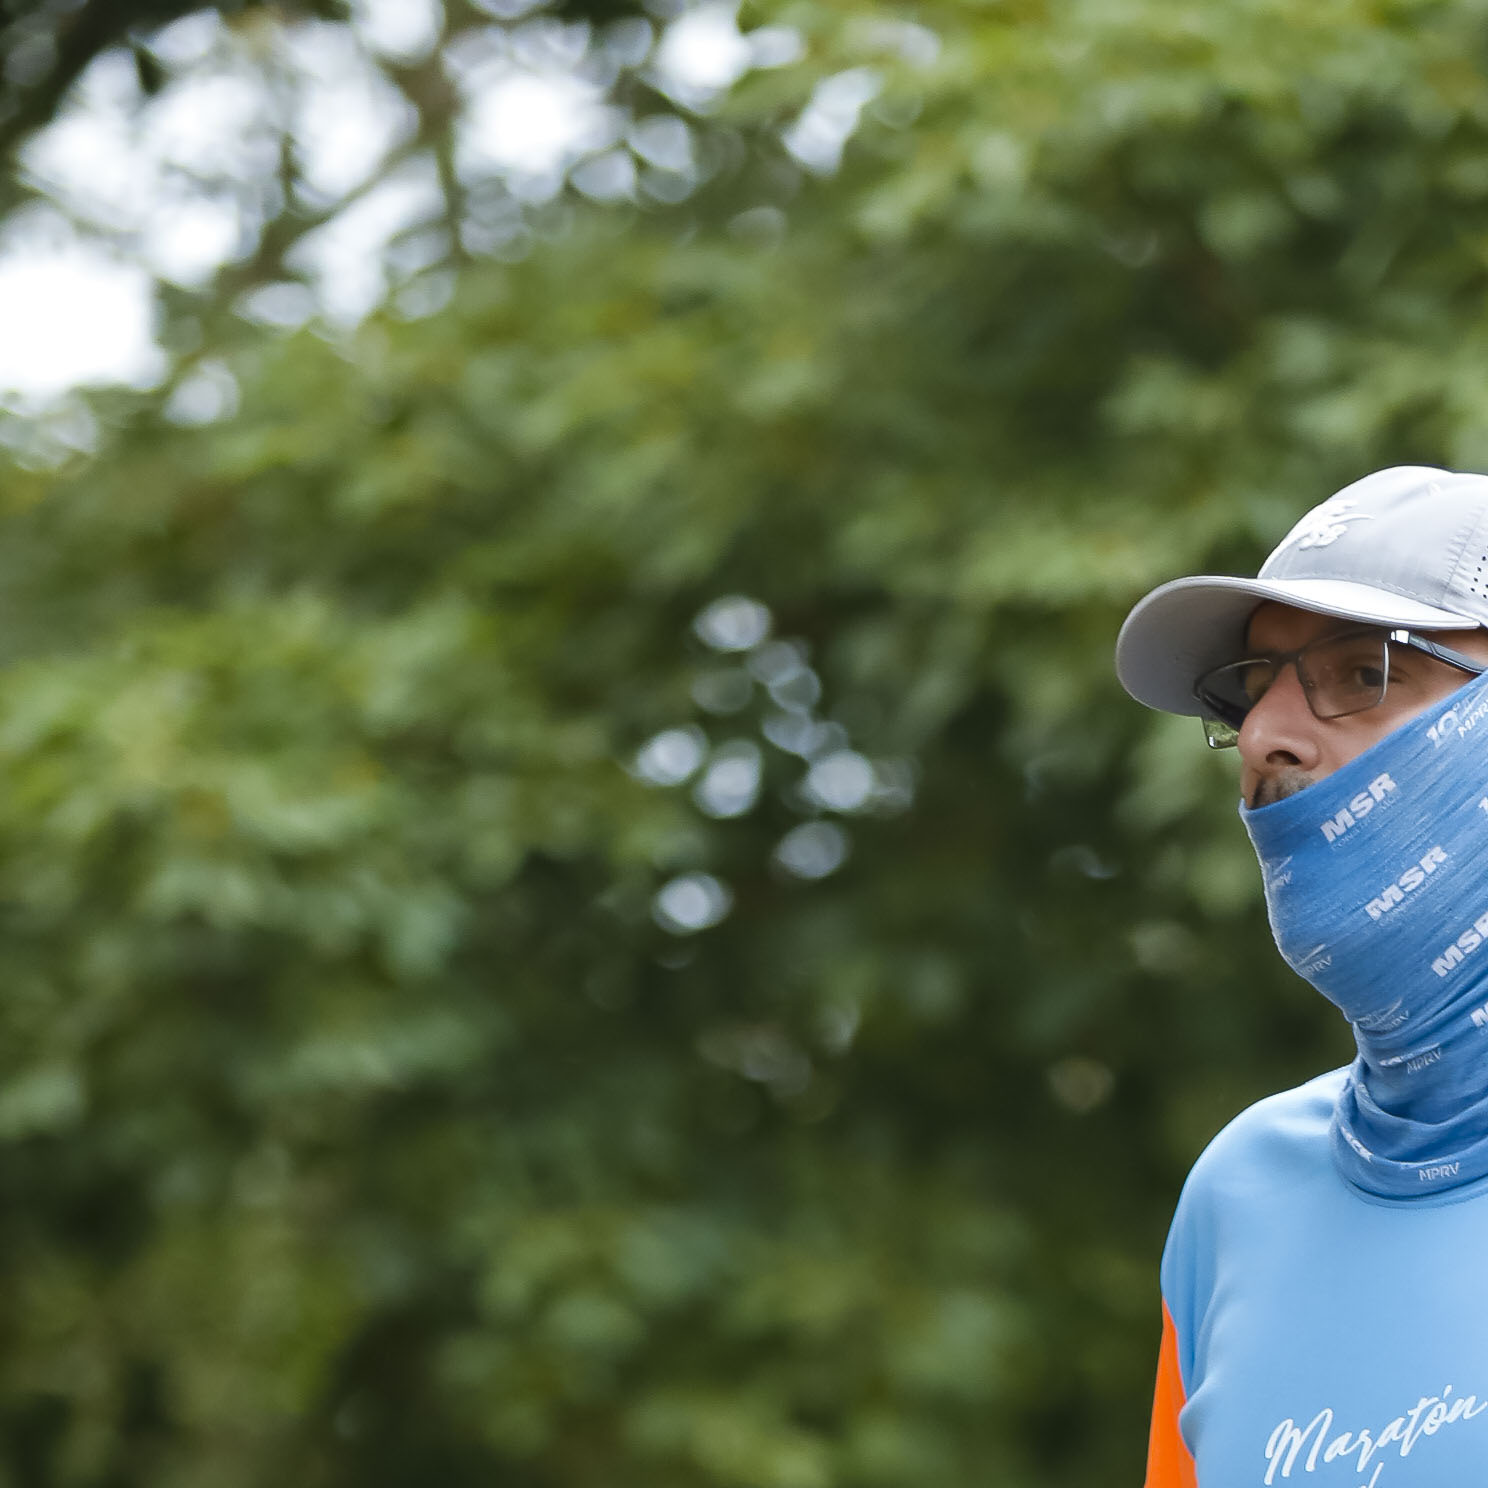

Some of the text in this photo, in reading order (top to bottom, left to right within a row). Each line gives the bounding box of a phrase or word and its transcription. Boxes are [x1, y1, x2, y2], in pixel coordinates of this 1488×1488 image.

[1320, 772, 1398, 844] MSR
[1364, 845, 1449, 921] MSR
[1406, 1047, 1442, 1076] MPRV
[1417, 1162, 1460, 1182] MPRV
[1262, 1384, 1488, 1486] Maratón
